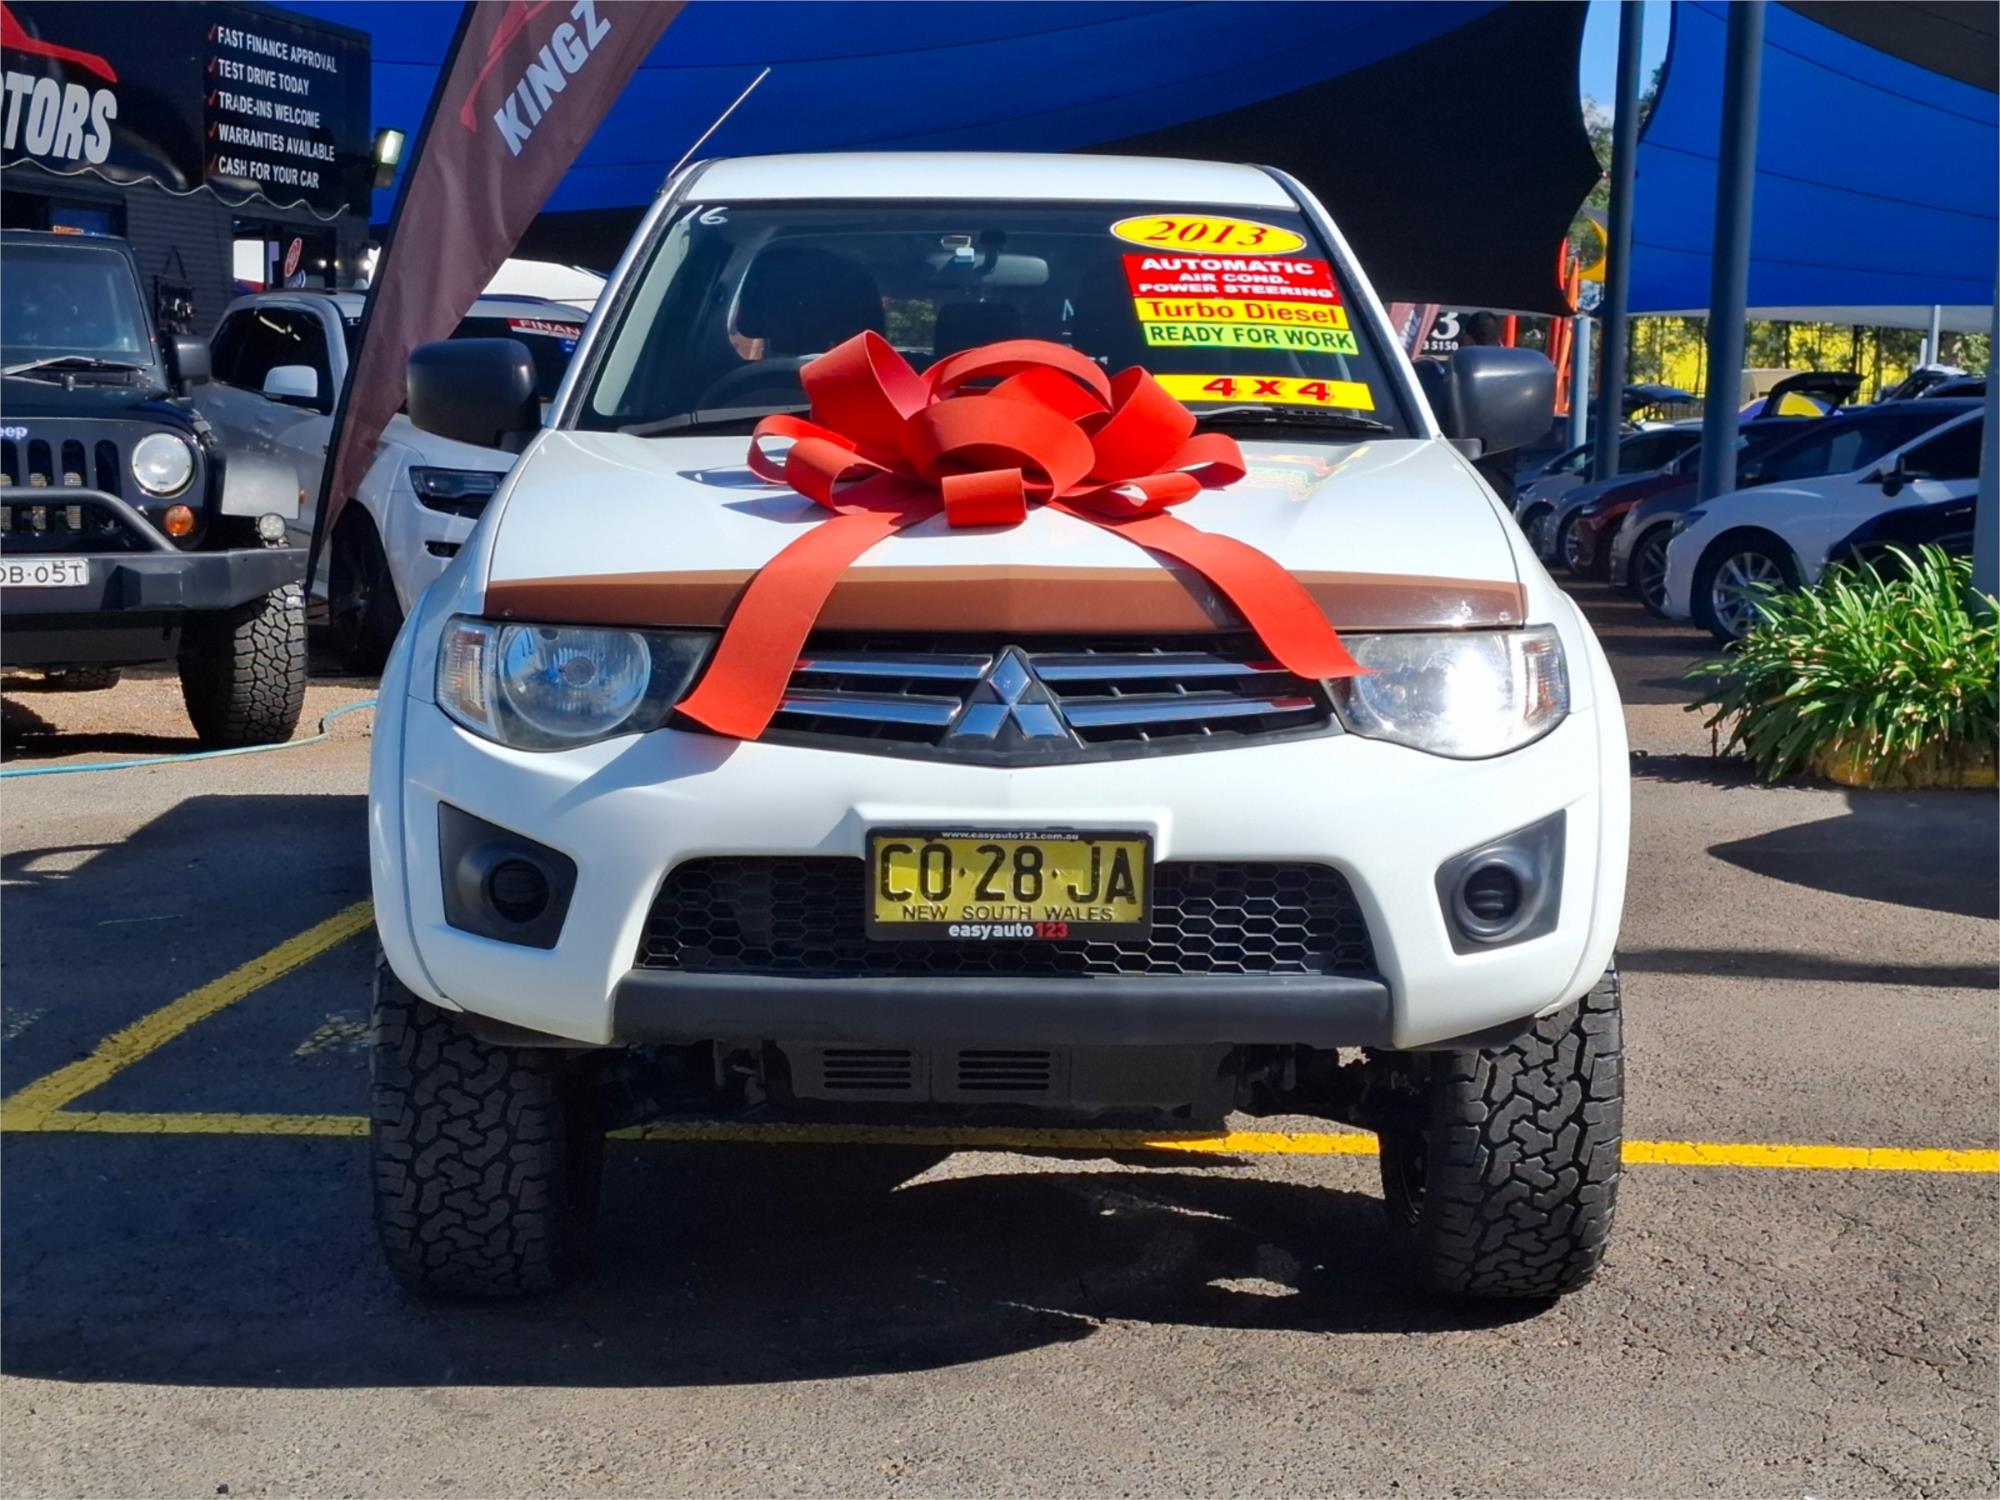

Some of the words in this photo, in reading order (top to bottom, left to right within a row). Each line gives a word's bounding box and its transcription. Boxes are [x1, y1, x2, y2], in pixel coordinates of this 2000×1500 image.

[217, 26, 244, 49] FAST
[246, 34, 289, 60] FINANCE
[290, 46, 338, 73] APPROVAL
[218, 58, 245, 80] TEST
[247, 66, 277, 88] DRIVE
[278, 73, 310, 96] TODAY
[494, 0, 611, 156] KINGZ
[0, 70, 118, 164] TORS
[218, 91, 273, 119] TRADE-INS
[274, 103, 321, 129] WELCOME
[218, 123, 285, 152] WARRANTIES
[286, 137, 335, 162] AVAILABLE
[218, 156, 247, 176] CASH
[250, 161, 271, 180] FOR
[272, 165, 298, 185] YOUR
[300, 170, 320, 189] CAR
[1144, 220, 1268, 246] 2013
[1141, 258, 1315, 275] AUTOMATIC
[1179, 272, 1218, 282] AIR
[1221, 273, 1291, 285] COND.
[1138, 283, 1219, 294] POWER
[1223, 284, 1334, 299] STEERING
[1146, 301, 1234, 319] Turbo
[1244, 303, 1338, 324] Diesel
[1150, 326, 1224, 342] READY
[1232, 328, 1280, 344] FOR
[1283, 330, 1354, 349] WORK
[1202, 377, 1237, 398] 4
[1297, 382, 1332, 402] 4
[941, 830, 1079, 842] www.easyauto123.com.au
[903, 906, 948, 921] NEW
[962, 906, 1032, 921] SOUTH
[1044, 906, 1114, 921] WALES
